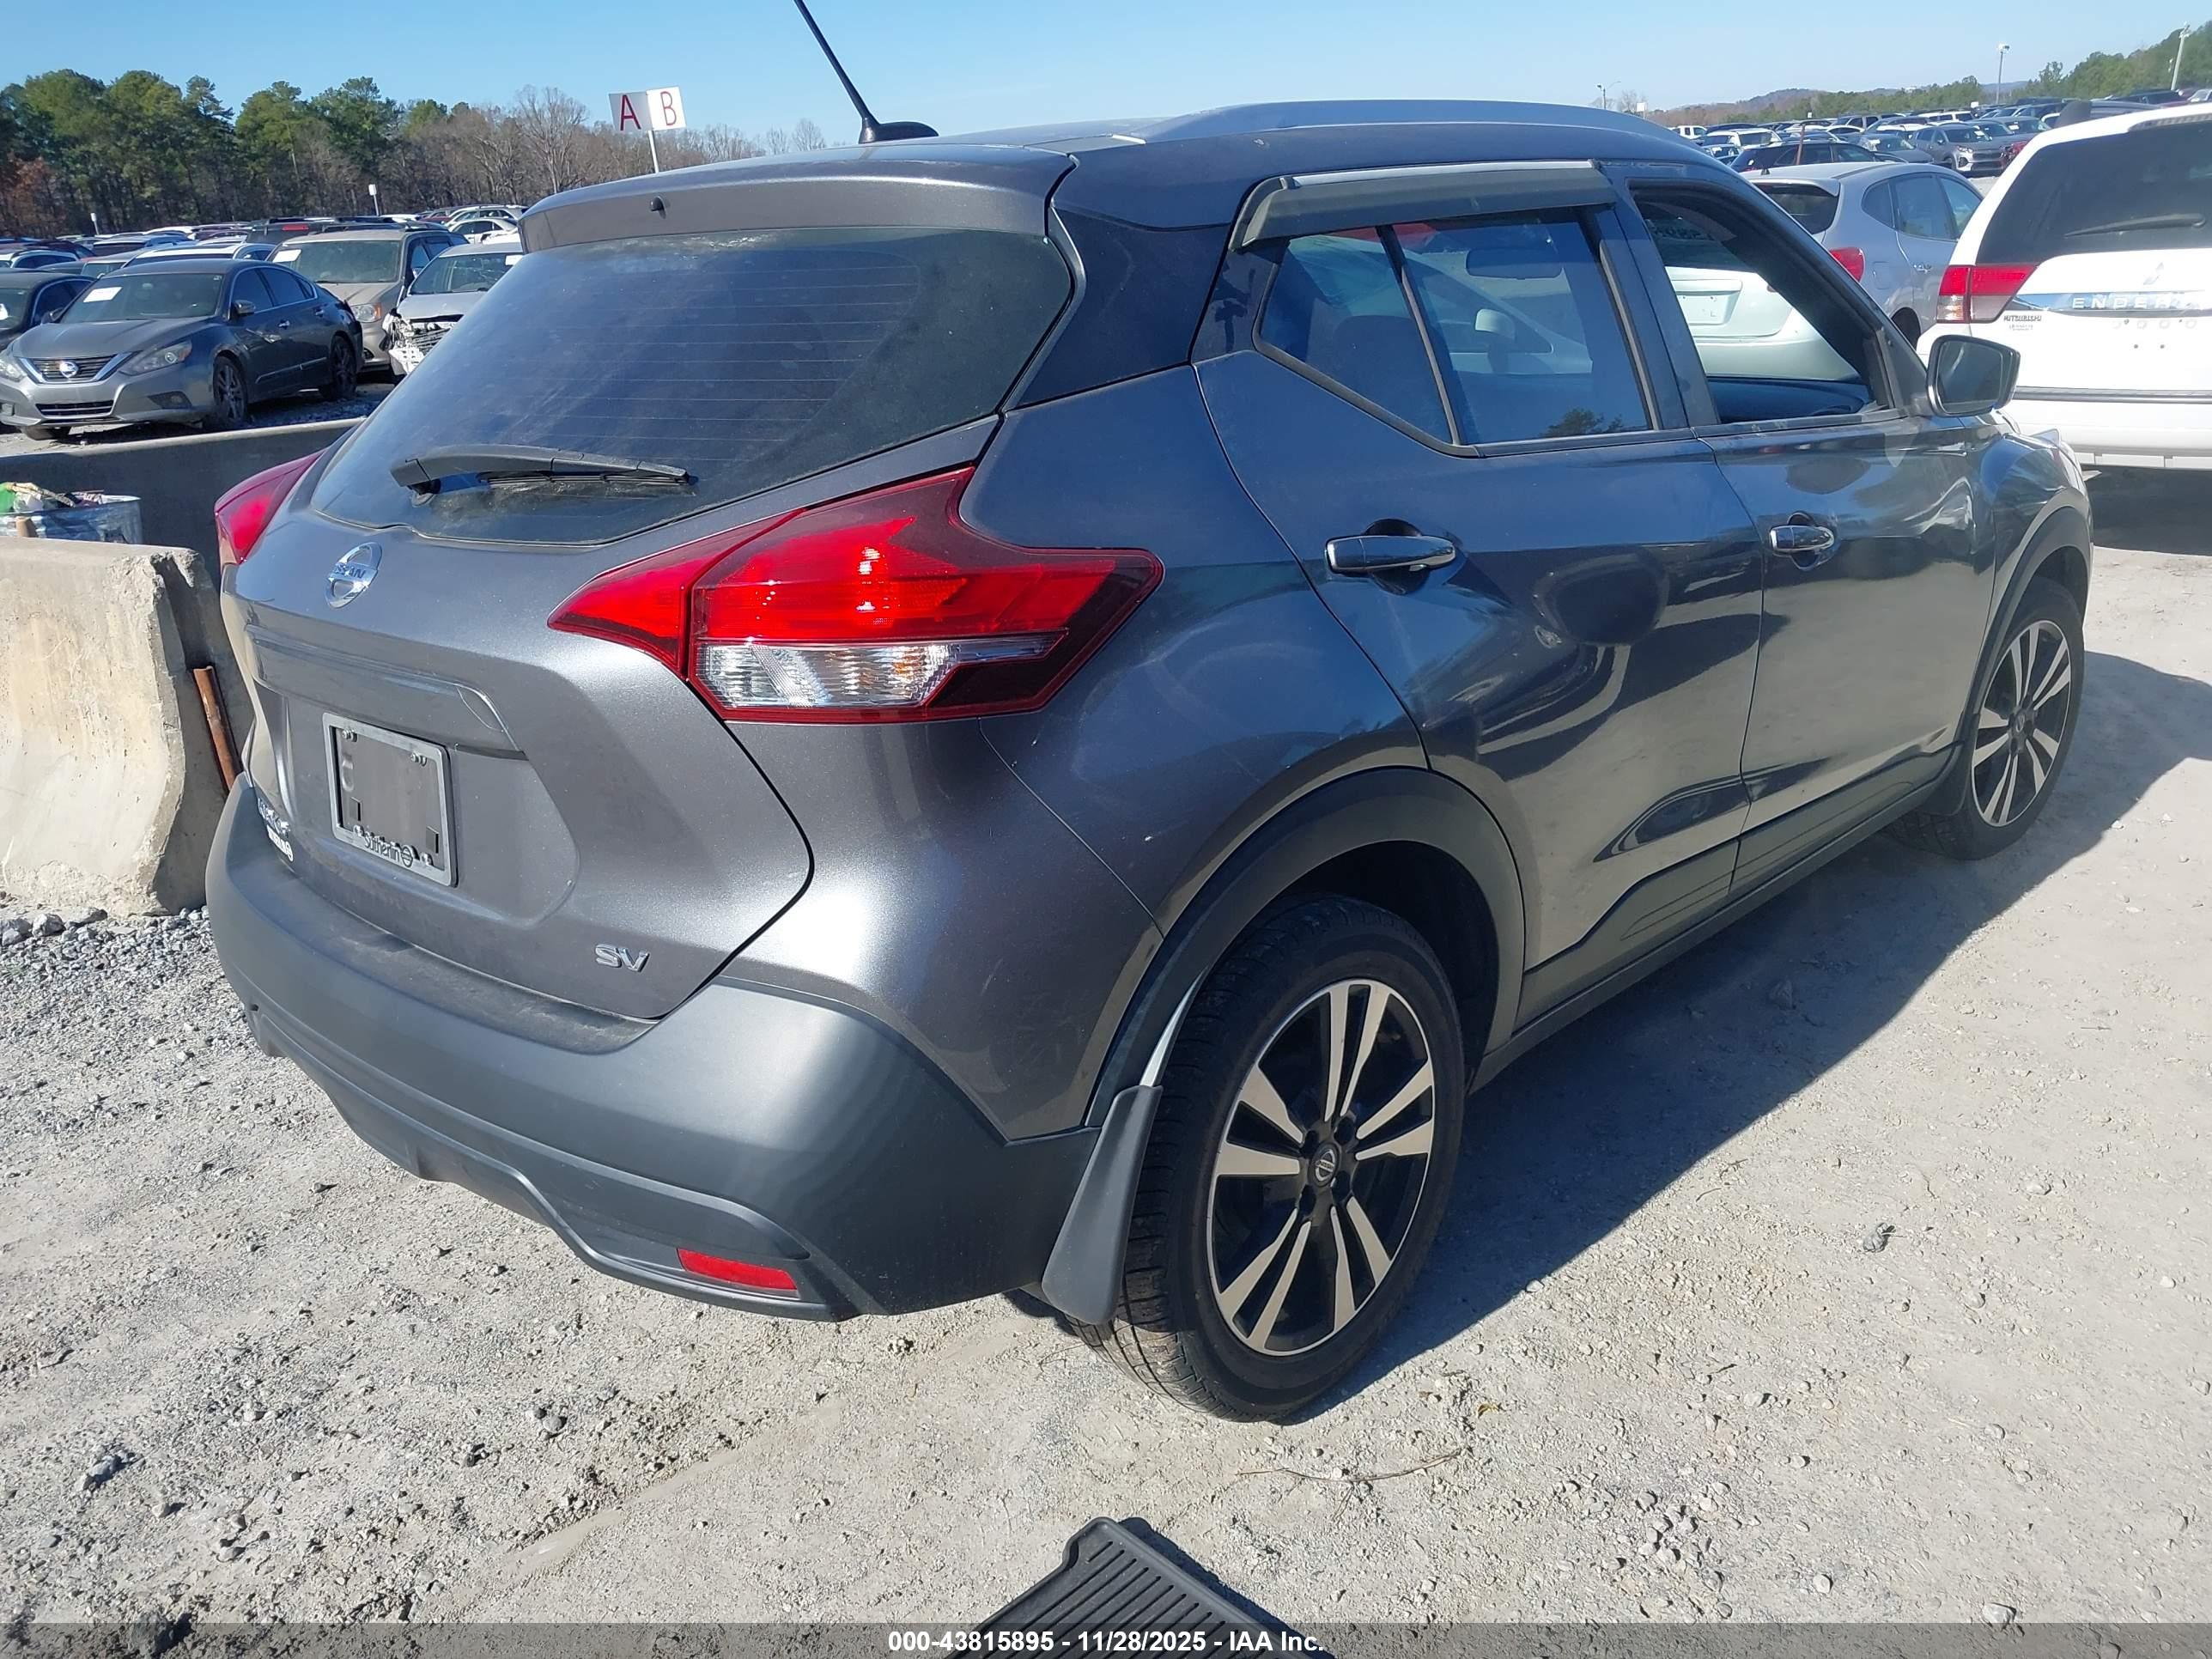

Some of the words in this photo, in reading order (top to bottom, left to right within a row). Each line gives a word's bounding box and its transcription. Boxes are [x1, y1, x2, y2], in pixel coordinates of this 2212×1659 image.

[620, 94, 641, 131] A
[660, 91, 678, 126] B
[595, 944, 650, 973] SV
